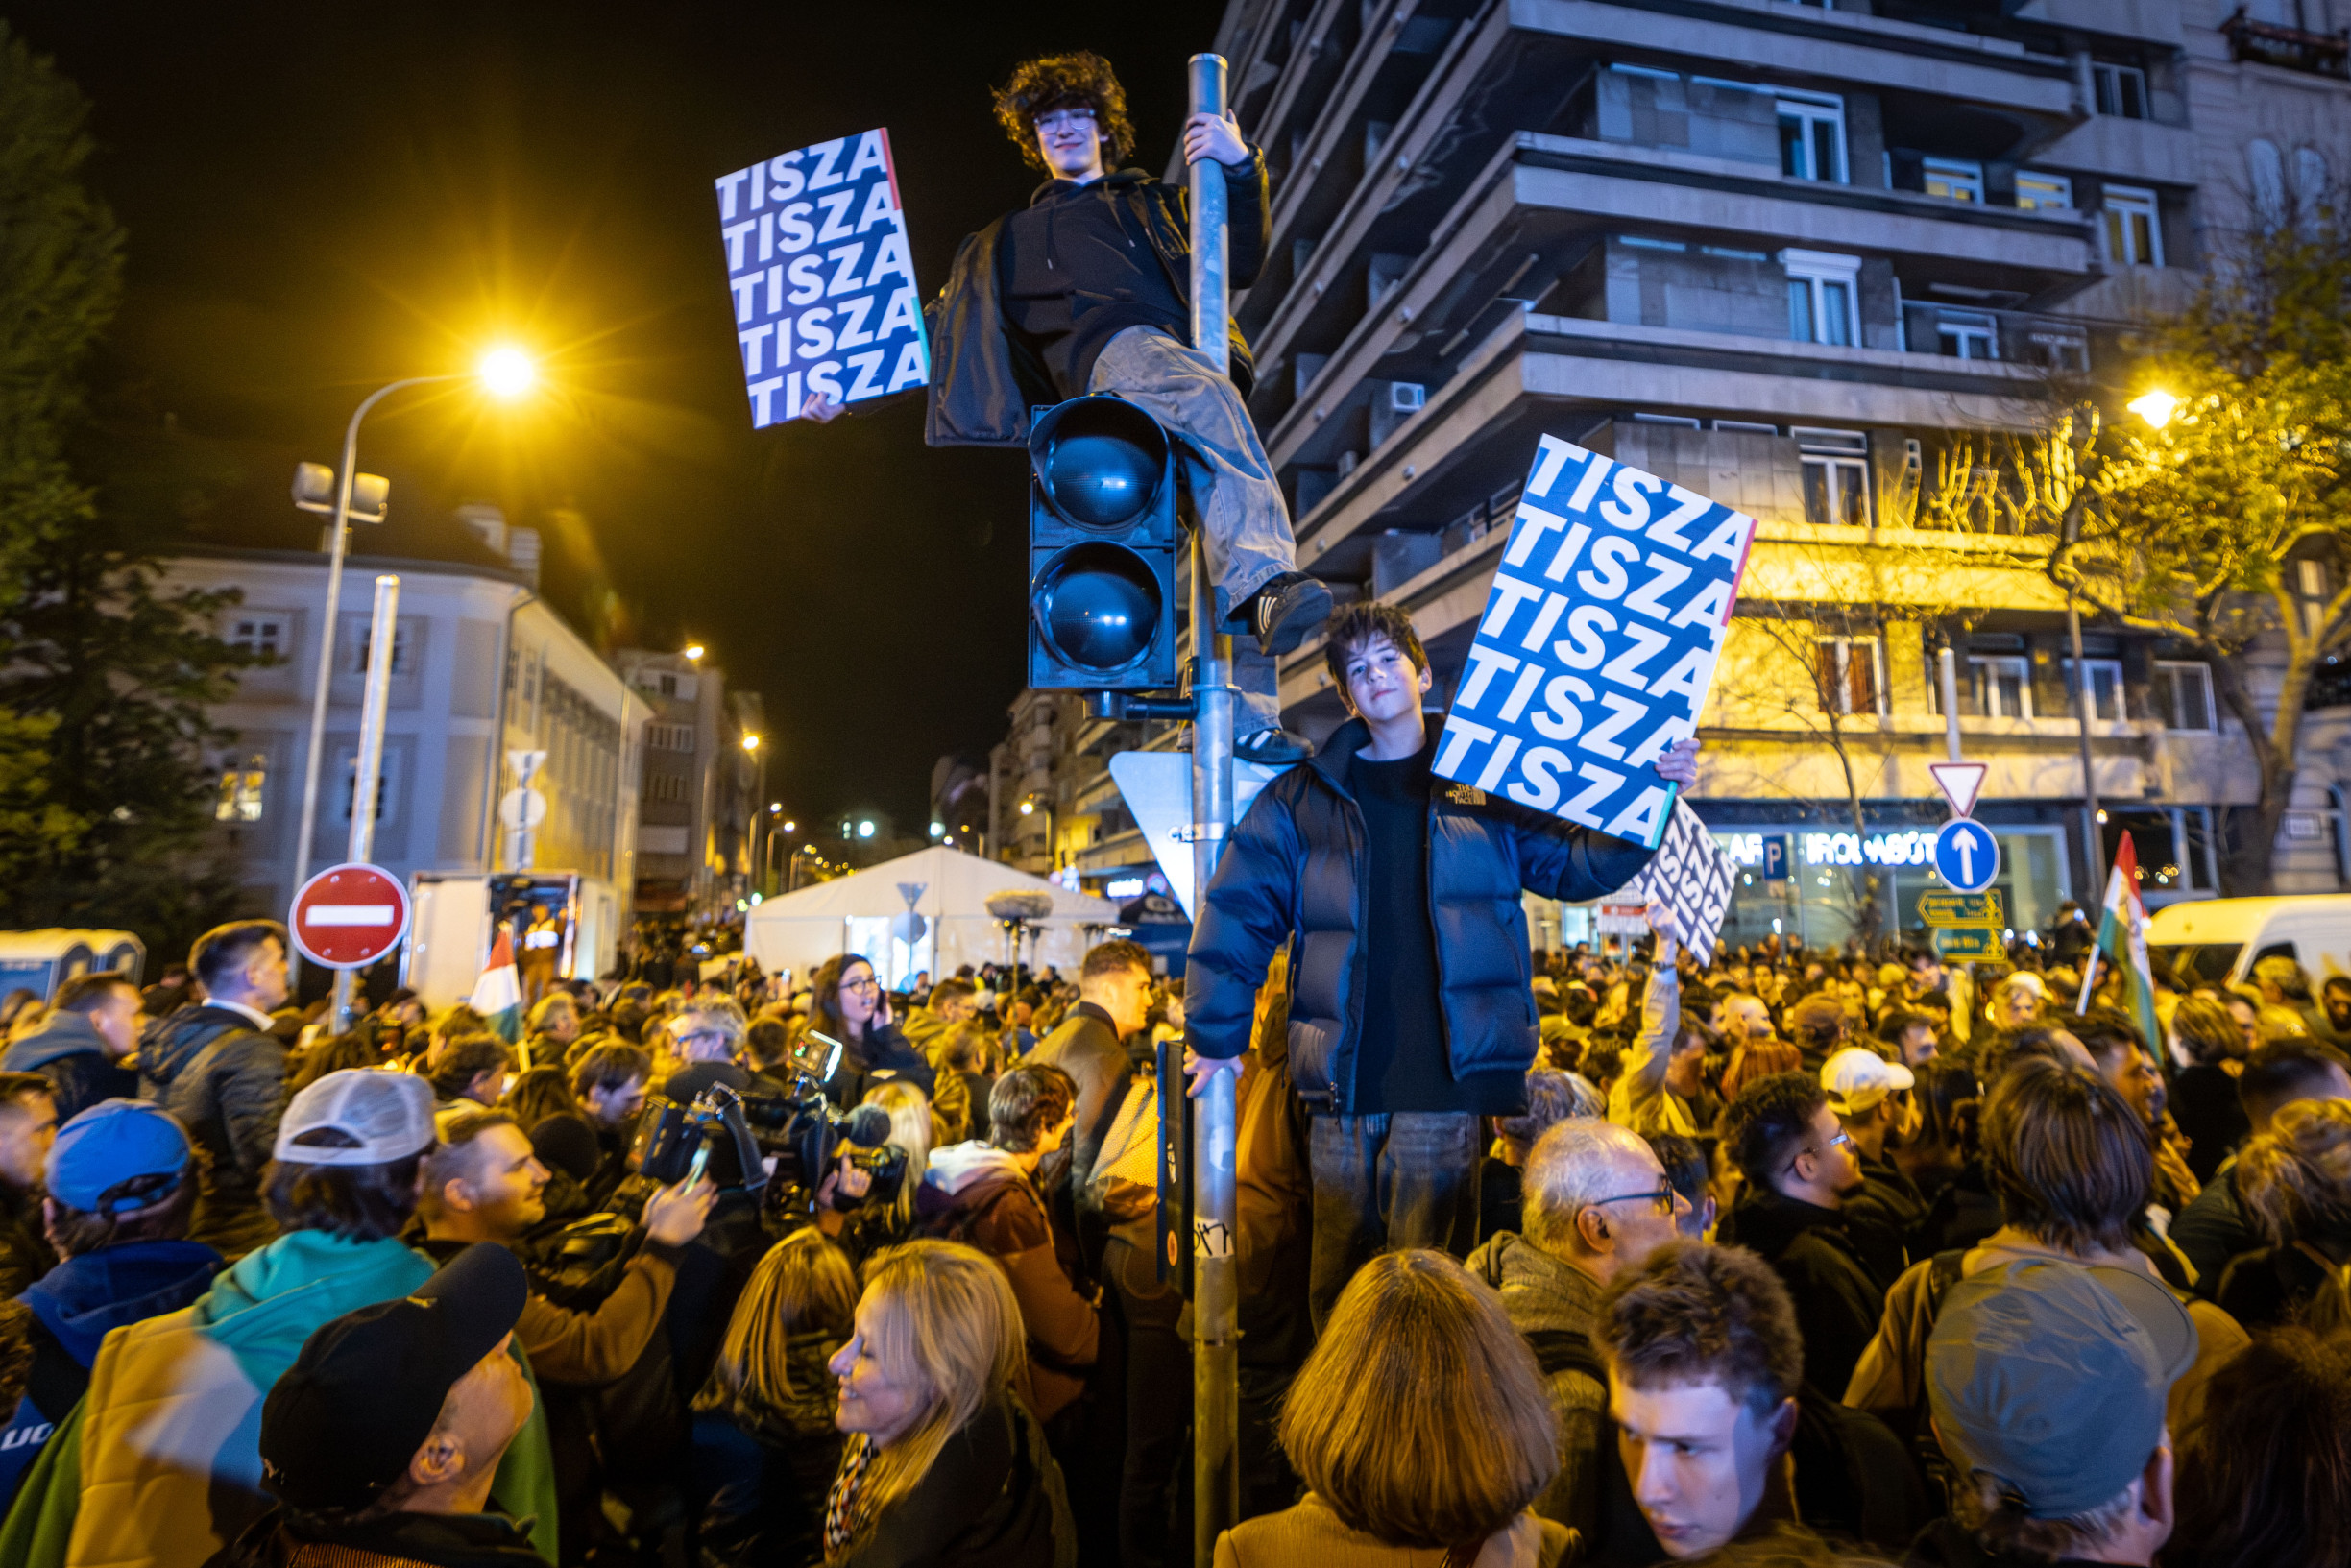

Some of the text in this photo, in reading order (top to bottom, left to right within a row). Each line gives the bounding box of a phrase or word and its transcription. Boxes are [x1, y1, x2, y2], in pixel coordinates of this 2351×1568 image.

[715, 129, 887, 220] TISZA
[723, 180, 898, 272] TISZA
[731, 232, 909, 324] TISZA
[739, 287, 918, 376] TISZA
[748, 340, 926, 428] TISZA
[1527, 439, 1754, 573] TISZA
[1504, 503, 1733, 641] TISZA
[1480, 574, 1715, 711] TISZA
[1456, 645, 1695, 768] TISZA
[1438, 717, 1667, 847] TISZA
[1689, 851, 1740, 968] TISZA
[1768, 841, 1782, 875] P
